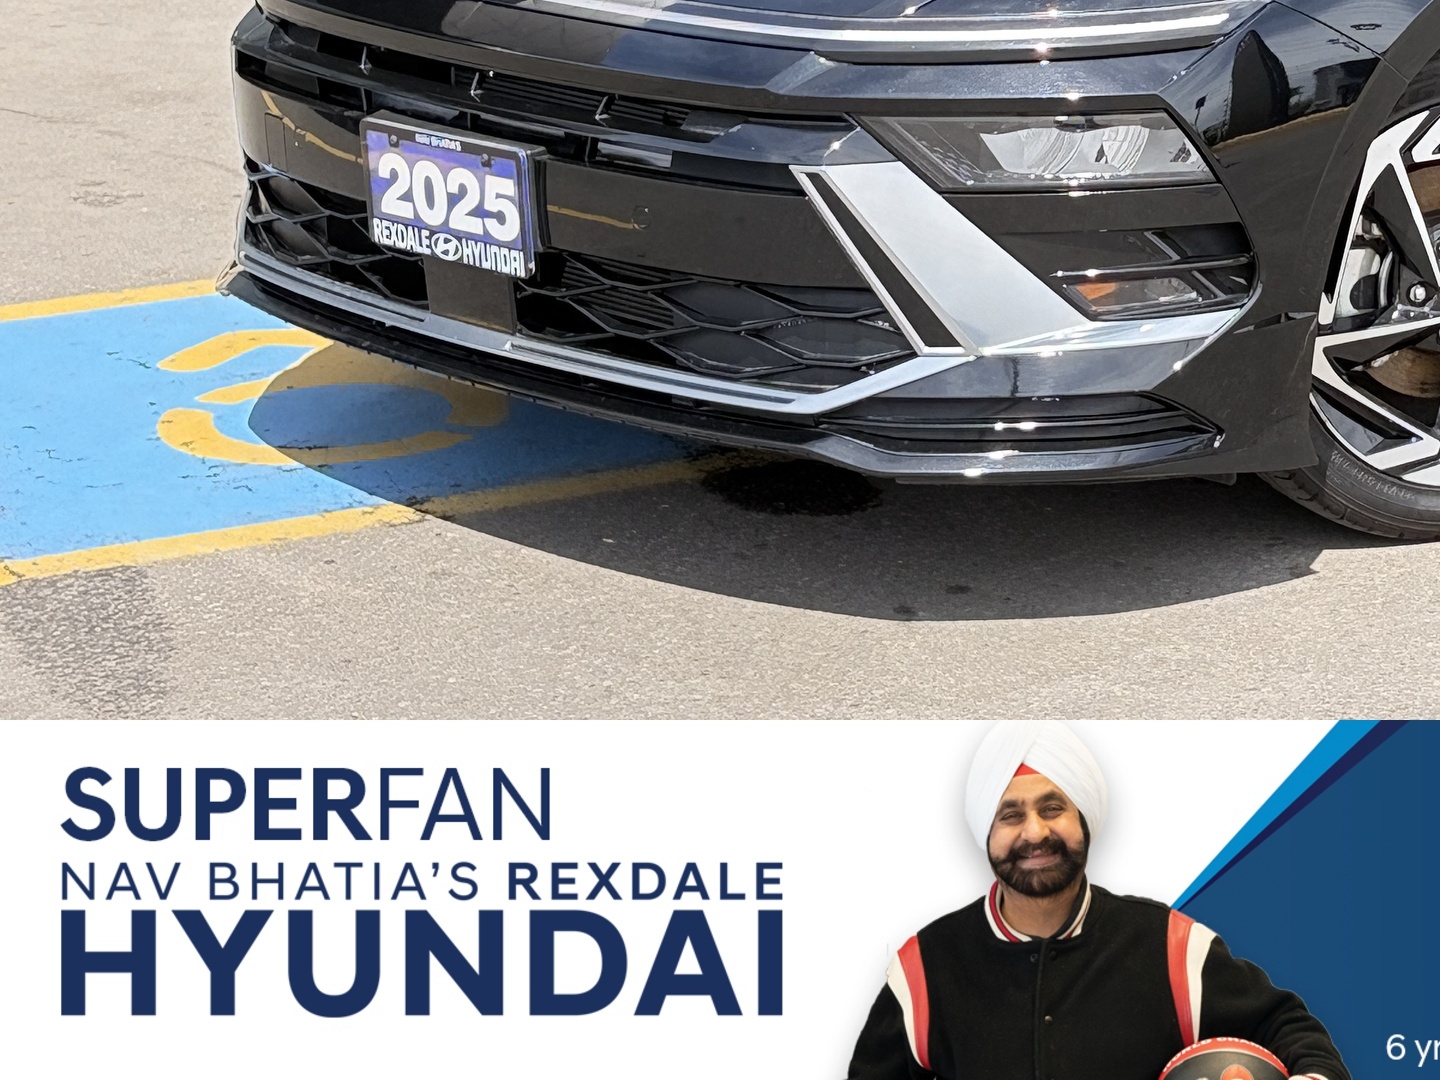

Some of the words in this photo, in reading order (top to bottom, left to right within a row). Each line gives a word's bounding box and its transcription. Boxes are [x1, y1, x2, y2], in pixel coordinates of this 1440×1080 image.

[378, 152, 521, 243] 2025
[373, 217, 431, 256] REXDALE
[461, 238, 526, 278] HYUNDAI
